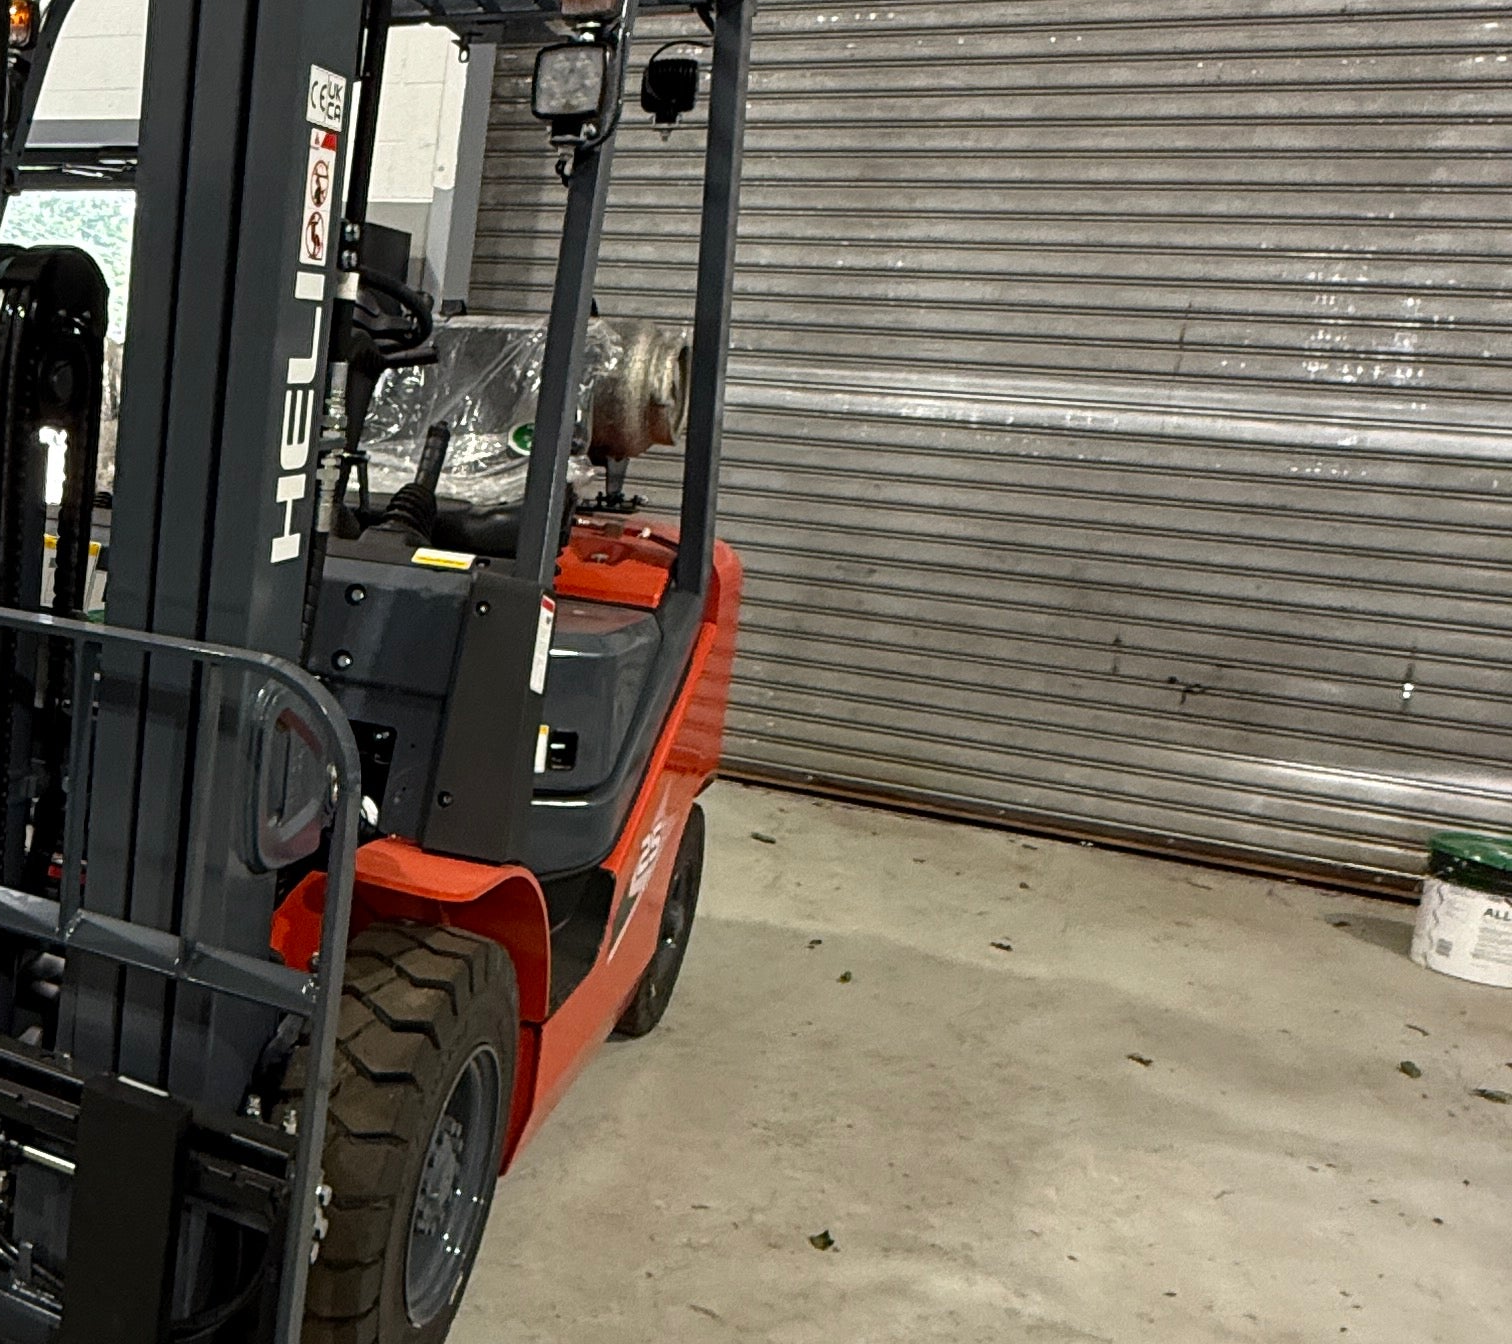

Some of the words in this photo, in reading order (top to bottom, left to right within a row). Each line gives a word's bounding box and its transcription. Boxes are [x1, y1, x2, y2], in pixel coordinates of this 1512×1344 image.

[310, 80, 327, 112] CE
[328, 81, 343, 103] UK
[327, 102, 341, 122] CA
[270, 270, 326, 563] HELI
